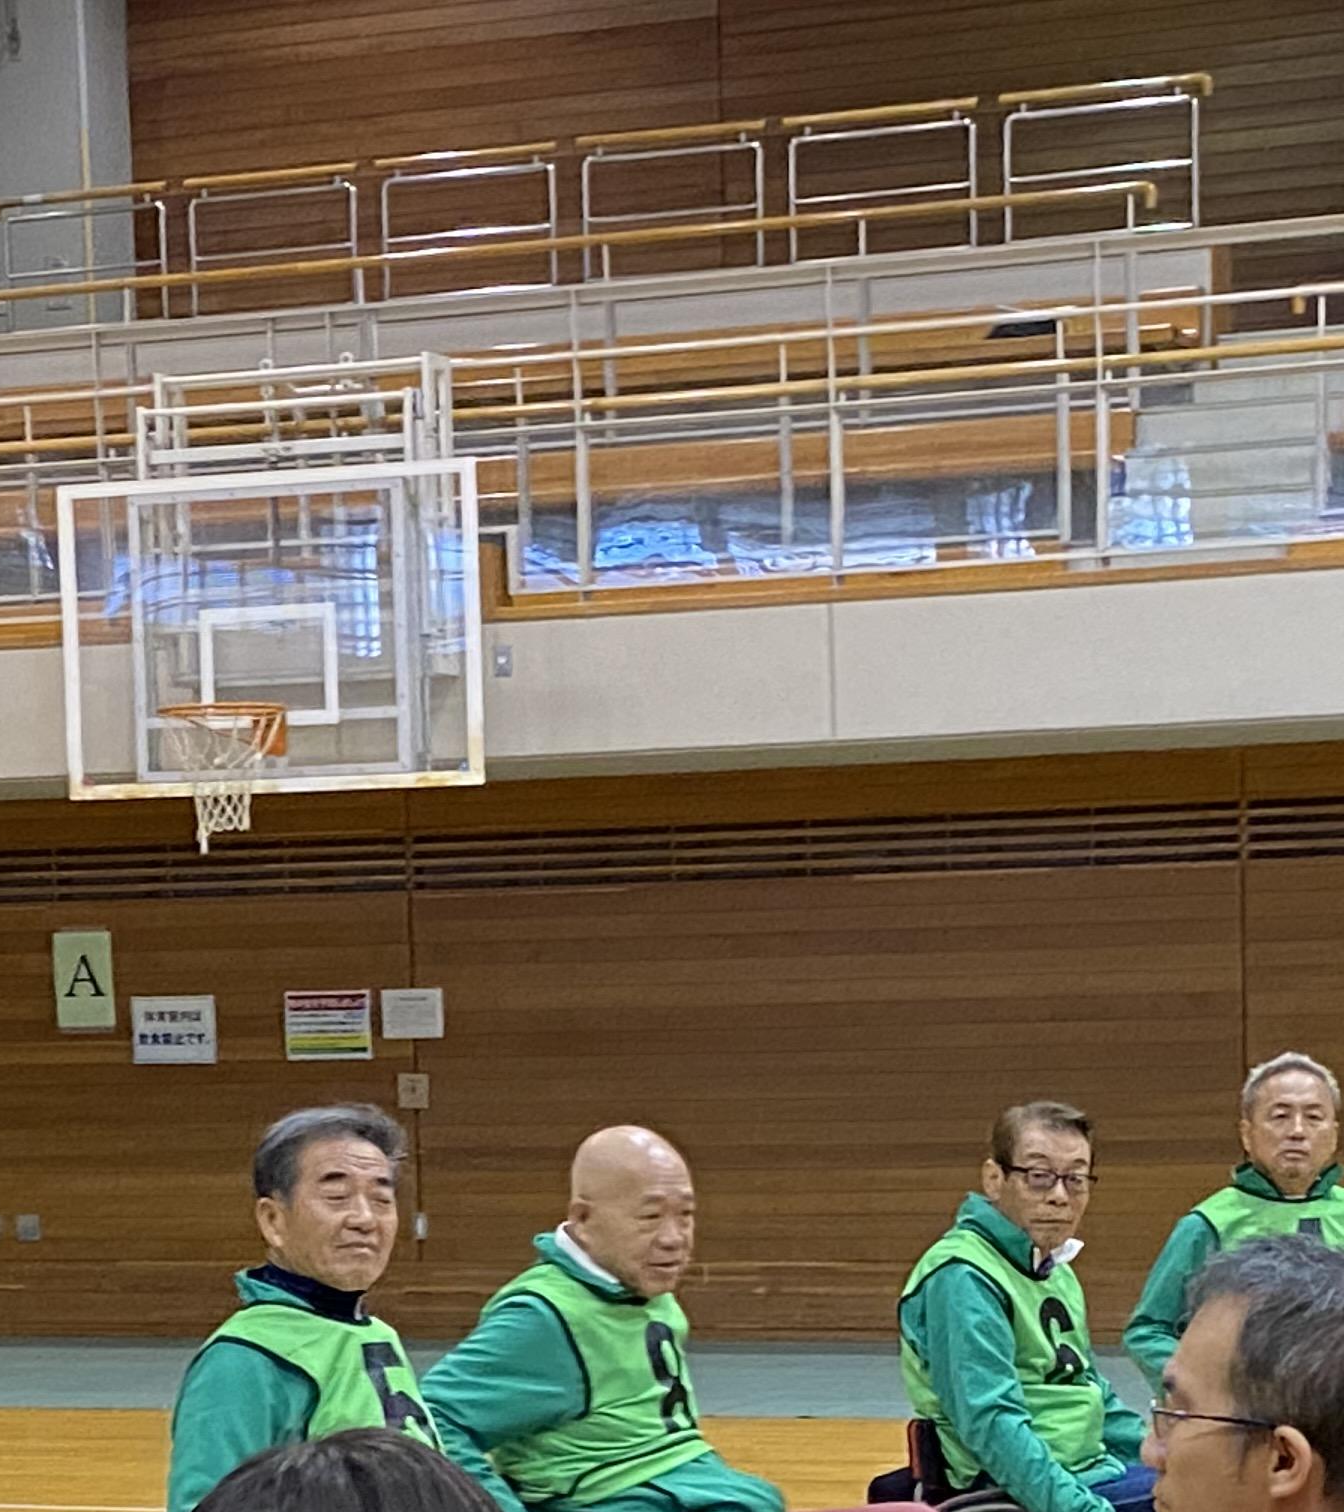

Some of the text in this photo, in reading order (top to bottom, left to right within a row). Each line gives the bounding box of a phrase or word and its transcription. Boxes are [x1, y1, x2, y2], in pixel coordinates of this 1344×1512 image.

[64, 954, 106, 997] A
[645, 1320, 697, 1434] 8
[1040, 1297, 1086, 1386] 6
[361, 1341, 442, 1449] 5
